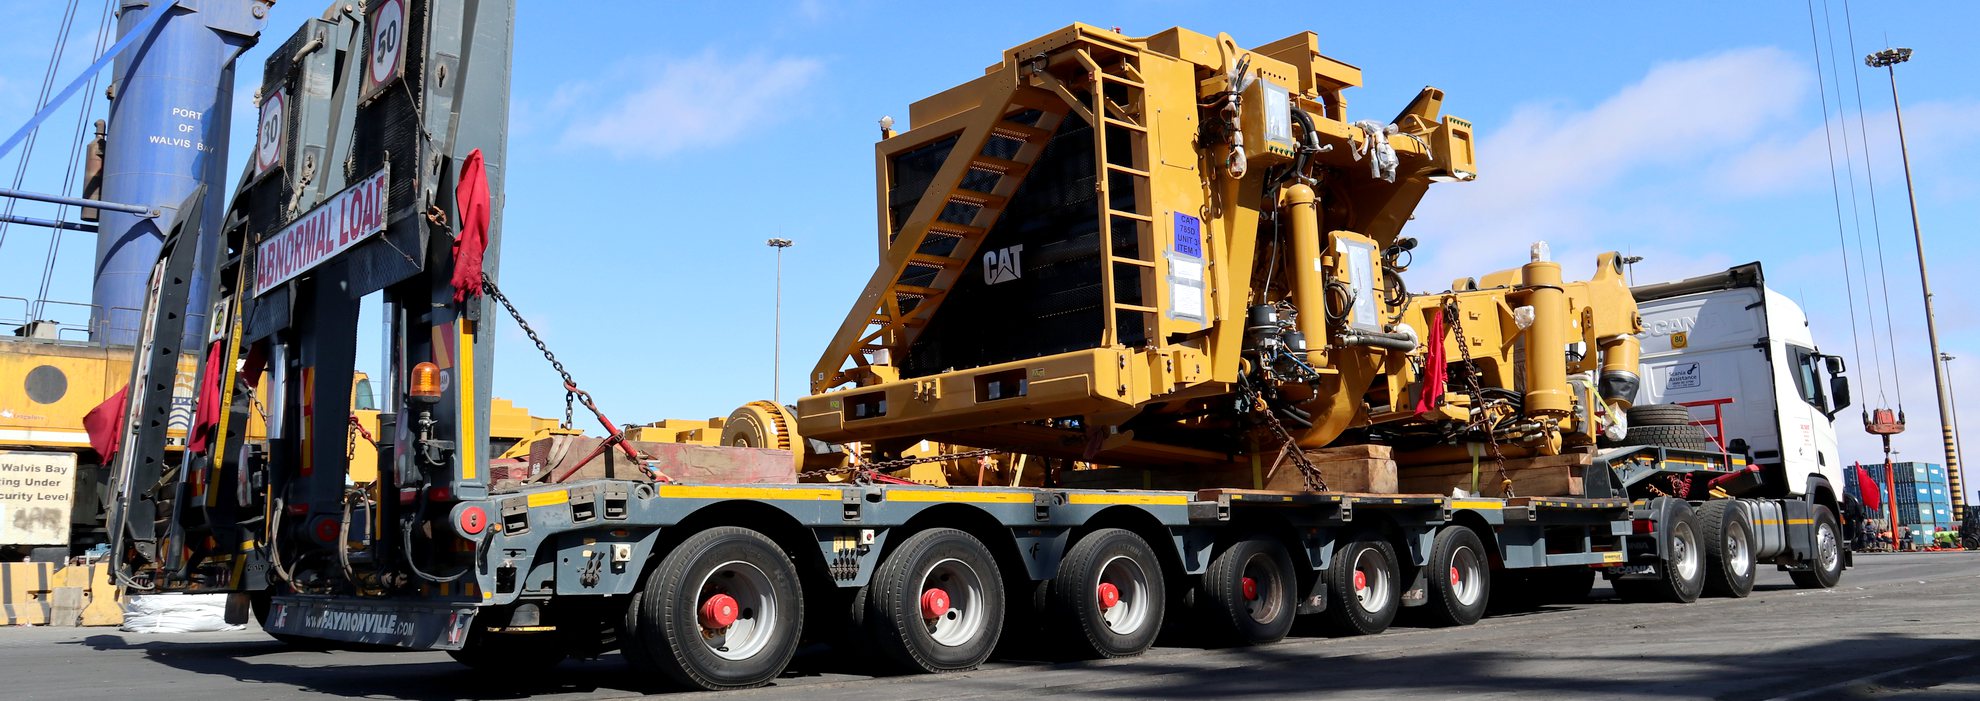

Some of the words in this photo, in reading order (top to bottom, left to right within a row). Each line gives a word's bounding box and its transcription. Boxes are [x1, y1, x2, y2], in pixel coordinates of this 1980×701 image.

[376, 19, 397, 64] 50
[172, 107, 203, 120] PORT
[178, 123, 195, 133] OF
[262, 114, 278, 149] 30
[149, 135, 191, 148] WALVIS
[197, 142, 214, 154] BAY
[1181, 215, 1194, 225] CAT
[257, 207, 334, 292] ABNORMAL
[339, 175, 384, 244] LOAD
[1177, 233, 1193, 246] UNIT
[1178, 245, 1194, 254] ITEM
[983, 244, 1023, 286] CAT
[1, 463, 41, 473] Walvis
[45, 464, 68, 475] Bay
[25, 478, 61, 487] Under
[37, 492, 69, 501] Level
